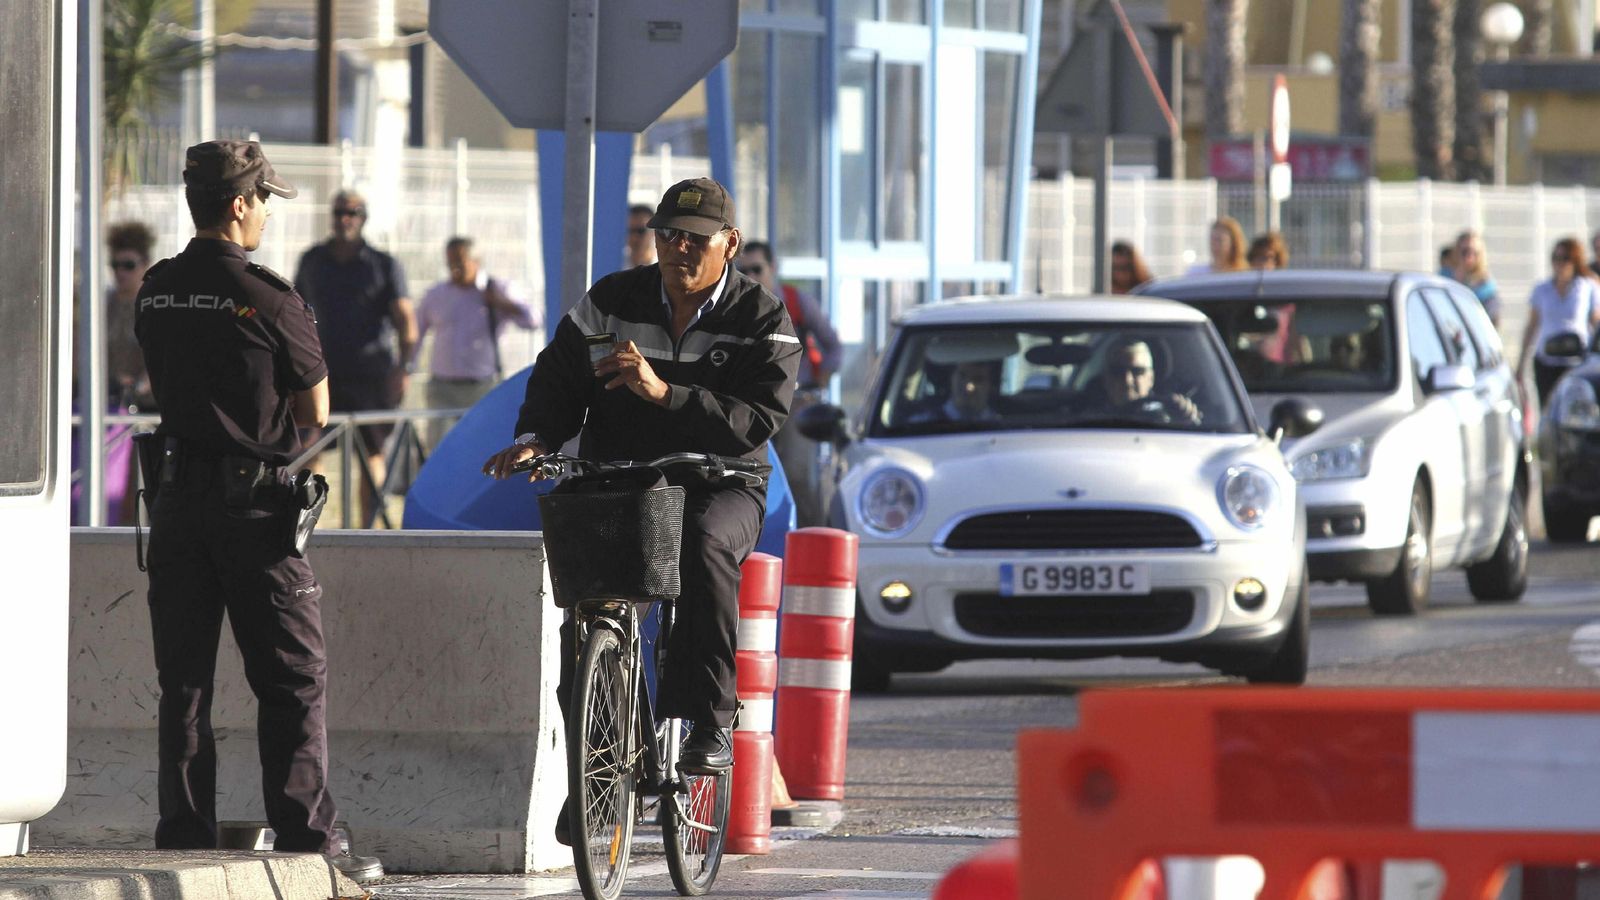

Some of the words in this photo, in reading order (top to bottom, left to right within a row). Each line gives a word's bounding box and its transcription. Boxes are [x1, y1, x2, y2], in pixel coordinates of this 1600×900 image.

[140, 294, 236, 312] POLICIA
[1022, 566, 1038, 590] G
[1044, 566, 1113, 590] 9983
[1119, 565, 1135, 590] C
